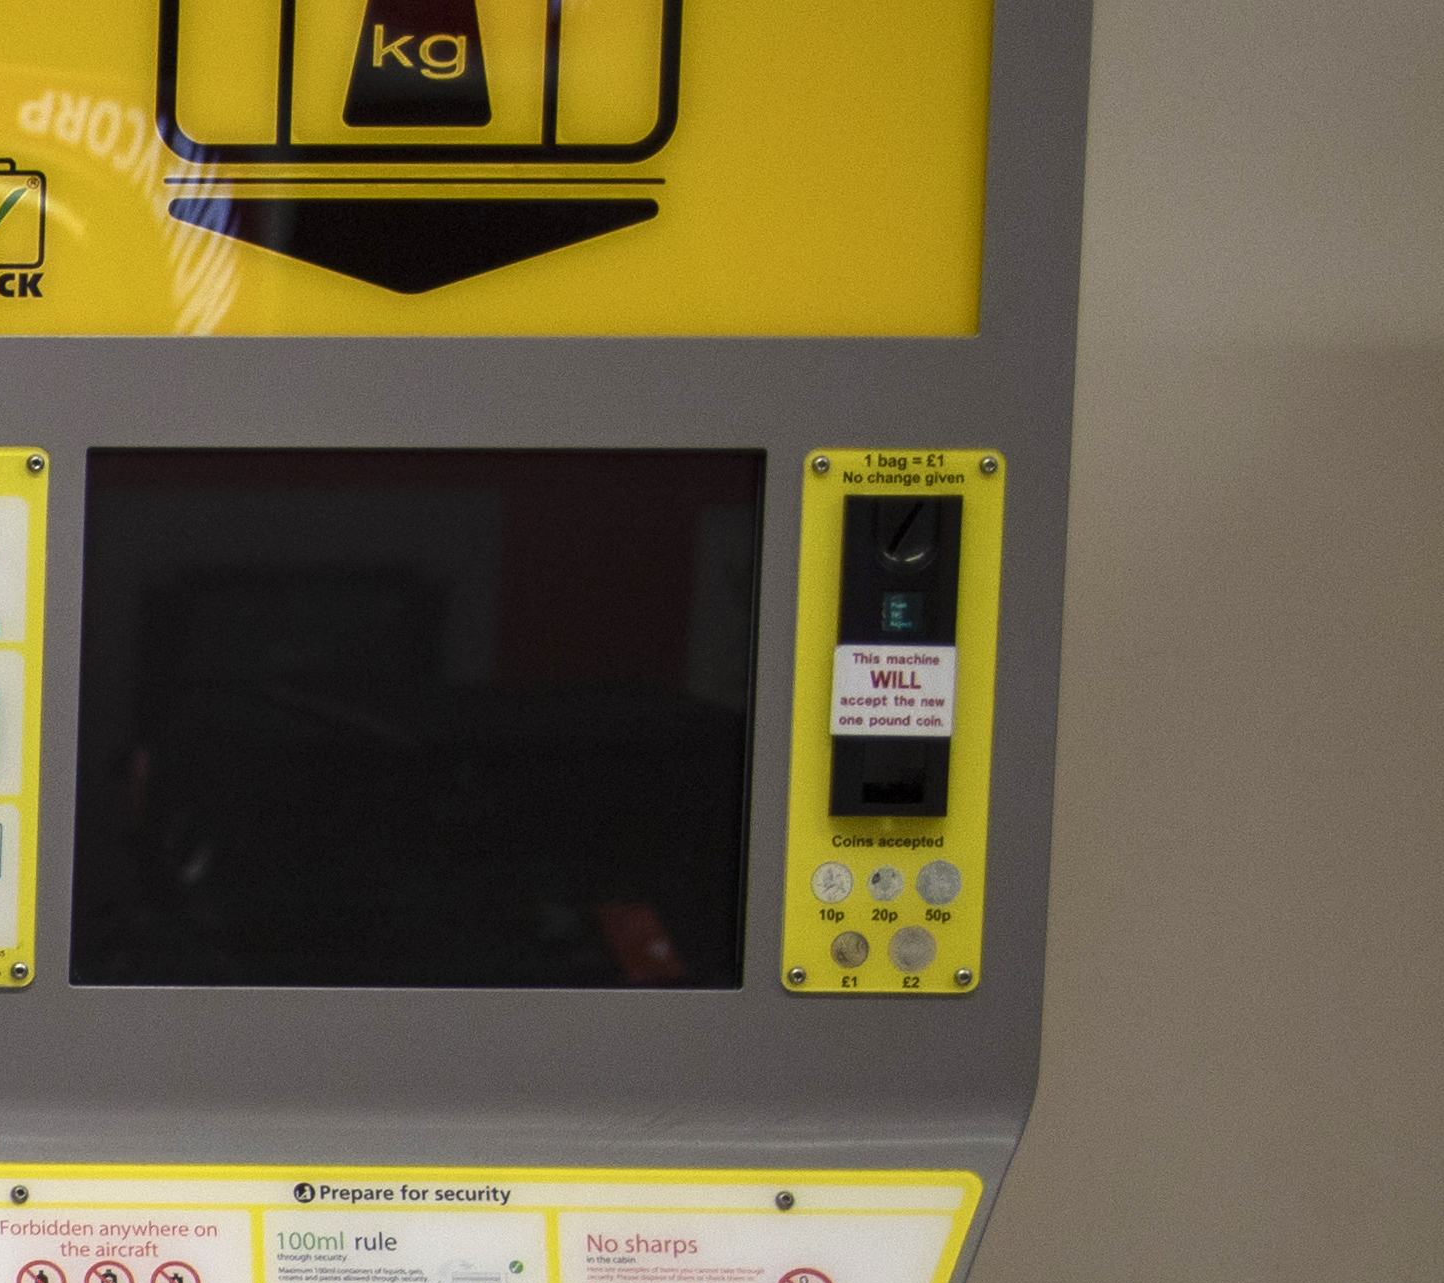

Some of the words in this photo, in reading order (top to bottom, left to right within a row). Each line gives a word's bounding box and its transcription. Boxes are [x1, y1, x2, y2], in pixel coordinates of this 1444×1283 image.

[371, 25, 468, 79] kg
[865, 453, 871, 467] 1
[877, 453, 908, 469] bag
[926, 454, 943, 468] £1
[843, 471, 863, 483] No
[867, 471, 920, 486] change
[924, 472, 964, 486] given
[852, 652, 880, 664] This
[886, 652, 940, 665] machine
[870, 669, 921, 689] WILL
[839, 694, 887, 708] accept
[893, 695, 915, 707] the
[920, 698, 945, 707] new
[838, 716, 863, 725] one
[868, 714, 911, 727] pound
[915, 714, 943, 727] coin.
[831, 834, 875, 848] Coins
[877, 834, 944, 850] accepted
[819, 907, 844, 923] 10p
[871, 907, 898, 924] 20p
[925, 907, 951, 924] 50p
[841, 975, 857, 988] £1
[902, 975, 920, 988] £2
[319, 1184, 394, 1206] Prepare
[400, 1184, 428, 1206] for
[434, 1185, 510, 1207] security
[0, 1218, 93, 1236] Forbidden
[98, 1220, 189, 1241] anywhere
[193, 1224, 217, 1237] on
[276, 1231, 345, 1250] 100ml
[354, 1231, 397, 1251] rule
[587, 1235, 618, 1253] No
[625, 1234, 698, 1258] sharps
[59, 1241, 90, 1257] the
[95, 1241, 158, 1258] aircraft
[276, 1252, 312, 1262] through
[314, 1254, 347, 1262] security
[596, 1255, 611, 1263] the
[612, 1256, 636, 1264] cabin
